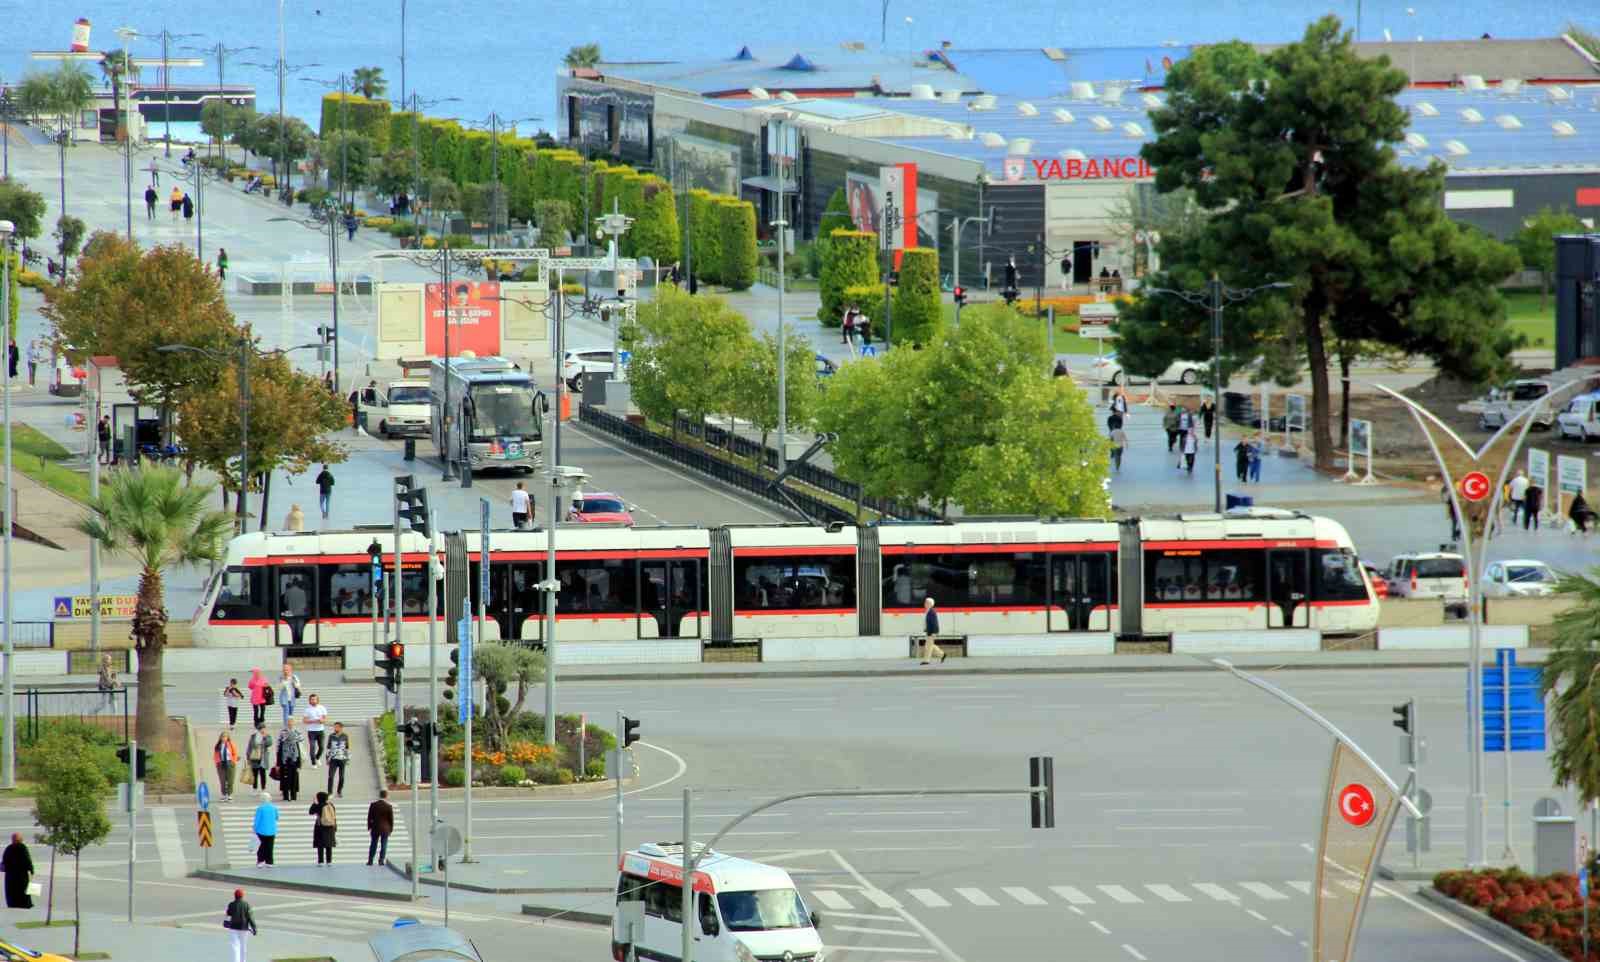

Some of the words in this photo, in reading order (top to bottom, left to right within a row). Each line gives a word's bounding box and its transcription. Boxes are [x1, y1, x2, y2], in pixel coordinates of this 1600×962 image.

[1032, 158, 1157, 179] YABANCIL
[75, 597, 113, 606] YAYAR
[74, 607, 113, 616] DİKAT
